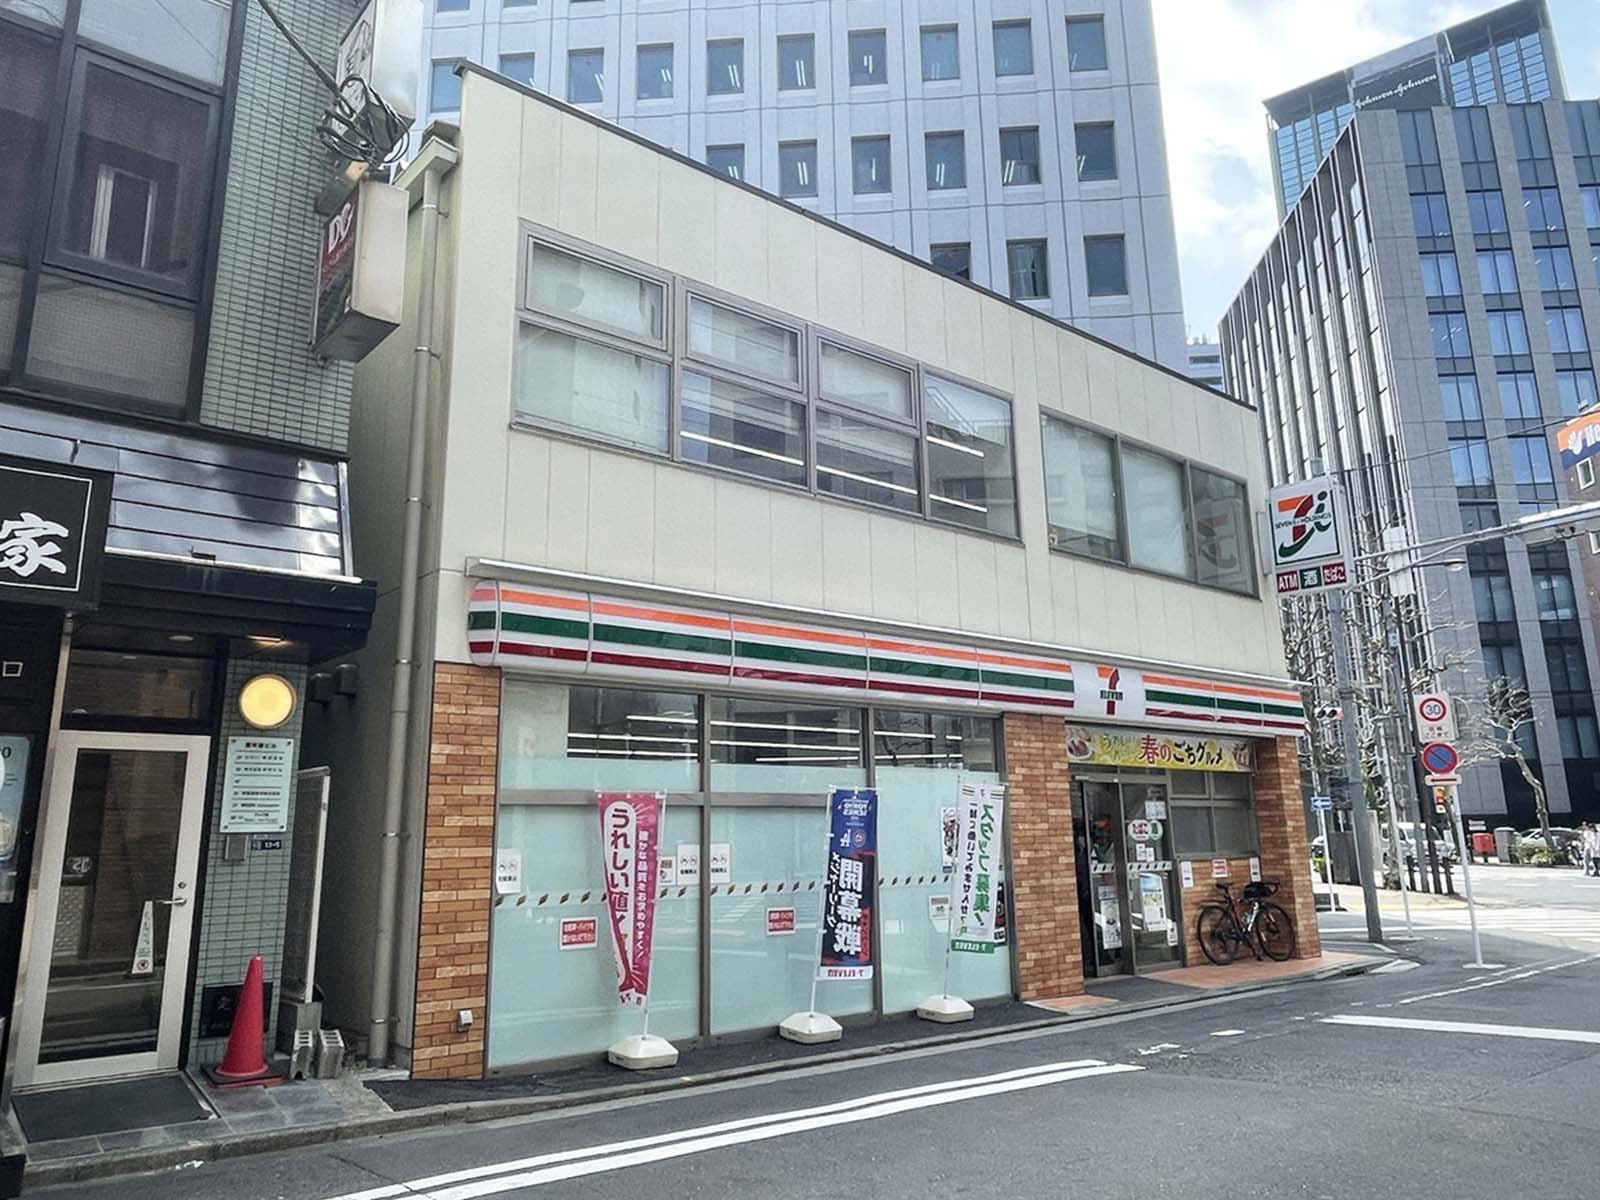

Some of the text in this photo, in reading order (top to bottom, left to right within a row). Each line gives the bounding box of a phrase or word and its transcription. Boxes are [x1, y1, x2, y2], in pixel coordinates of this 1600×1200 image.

[0, 512, 69, 577] 家
[1277, 573, 1299, 590] ATM
[1303, 569, 1318, 587] 酒
[1323, 565, 1346, 583] たばこ
[1425, 703, 1441, 716] 30
[1138, 733, 1224, 767] 春のごちグルメ
